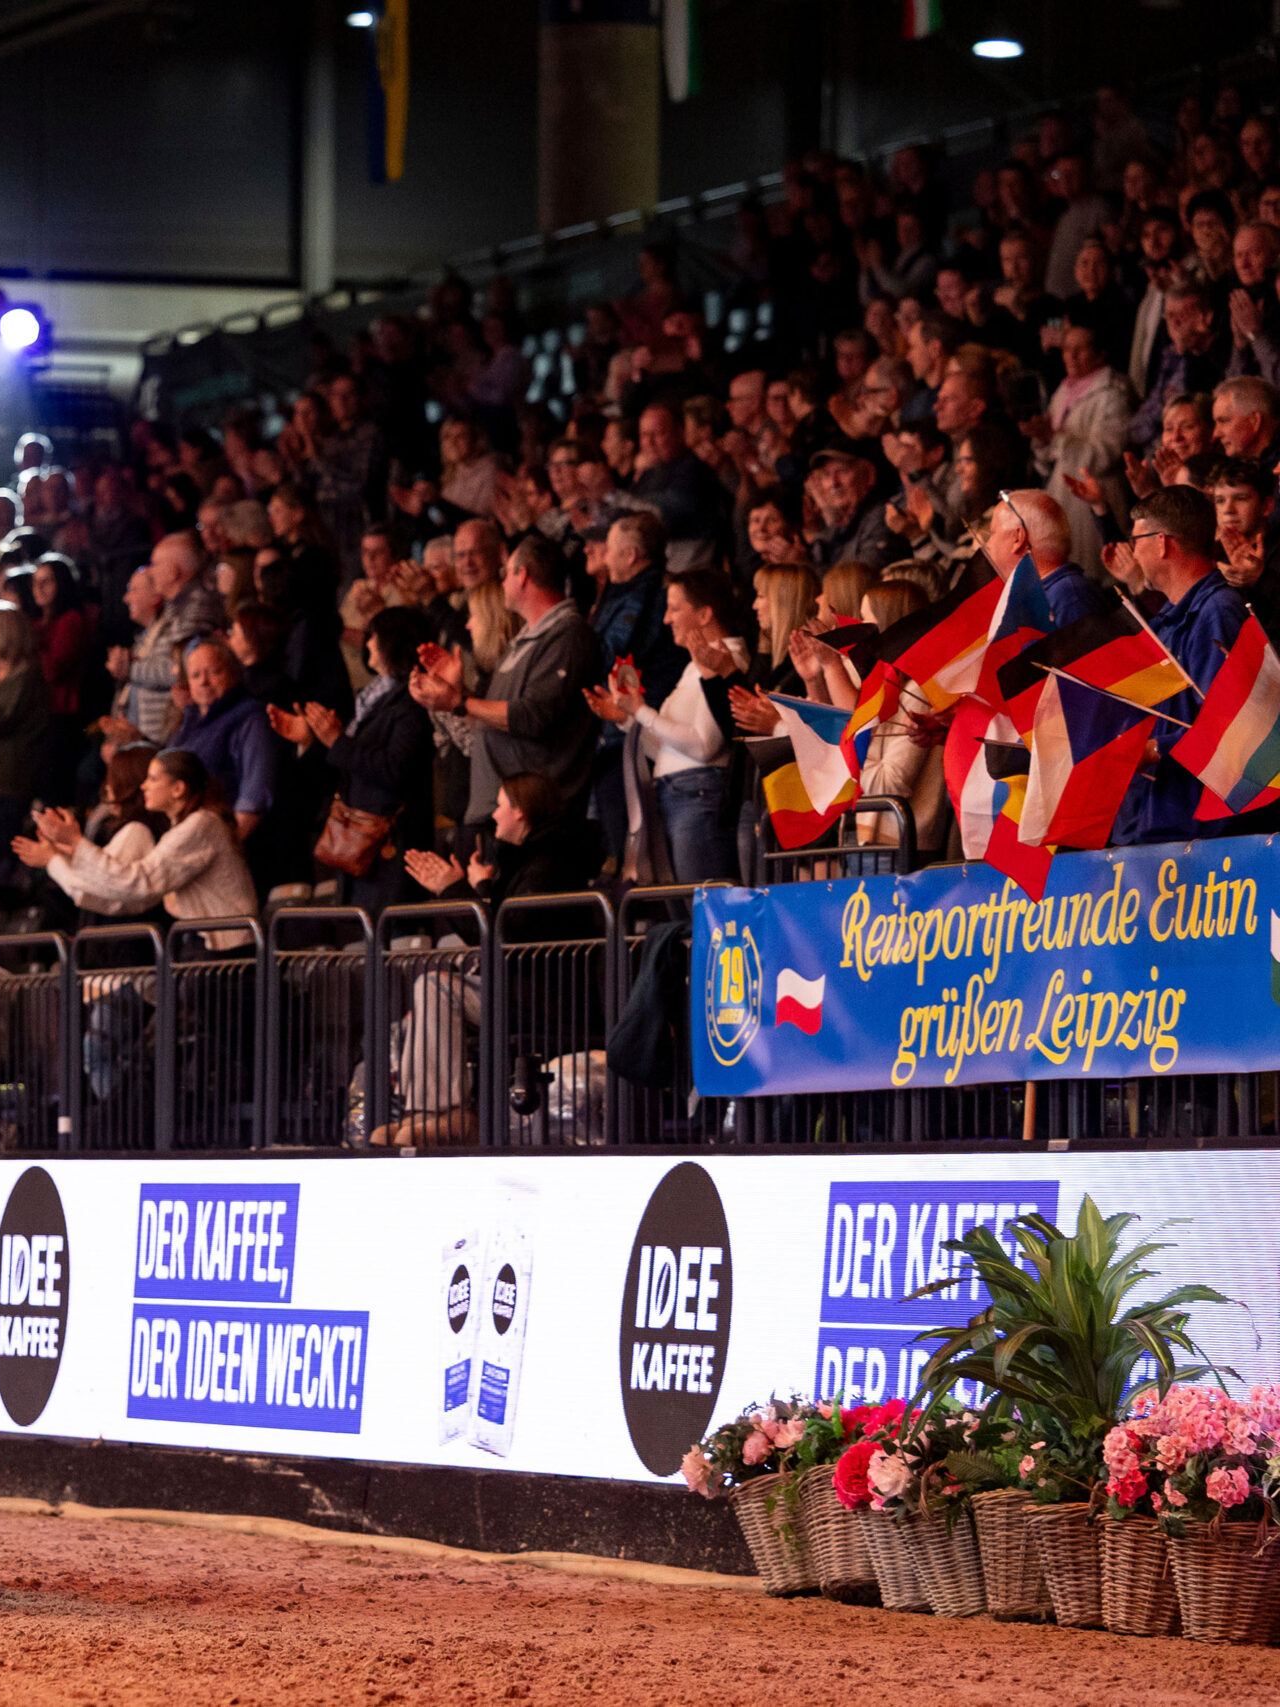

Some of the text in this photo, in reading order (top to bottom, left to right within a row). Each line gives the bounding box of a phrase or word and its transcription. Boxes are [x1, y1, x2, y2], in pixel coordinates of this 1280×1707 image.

[839, 857, 1258, 986] Reitsportfreunde Eutin
[719, 946, 745, 1004] 19
[890, 966, 1187, 1086] grüßen Leipzig
[0, 1235, 64, 1307] IDEE
[138, 1200, 289, 1298] DER KAFFEE,
[634, 1246, 723, 1332] IDEE
[828, 1202, 1039, 1300] DER KAFF
[131, 1318, 181, 1399] DER
[184, 1320, 261, 1404] IDEEN
[265, 1323, 363, 1411] WECKT!
[630, 1343, 715, 1394] KAFFEE
